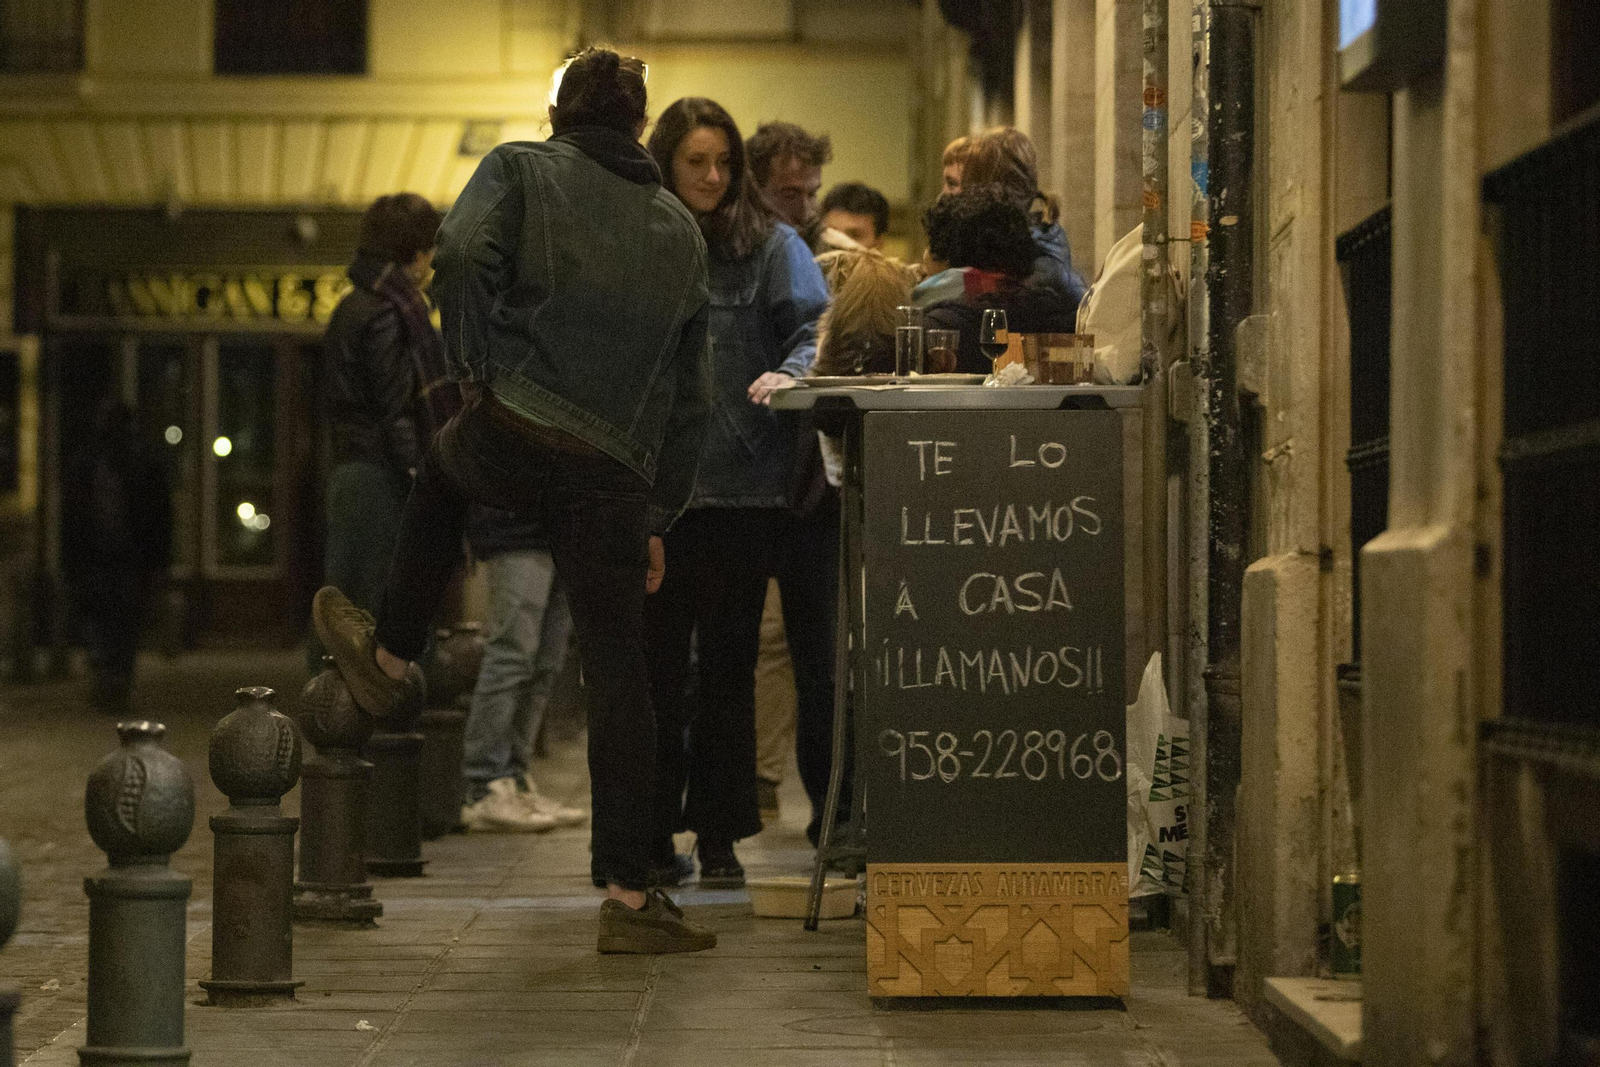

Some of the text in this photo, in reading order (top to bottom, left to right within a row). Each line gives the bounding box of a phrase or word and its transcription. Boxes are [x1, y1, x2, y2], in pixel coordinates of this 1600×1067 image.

[907, 435, 1067, 481] TE LO
[902, 496, 1101, 547] LLEVAMOS
[958, 567, 1073, 615] CASA
[878, 729, 1122, 783] 958-228968
[872, 871, 1120, 897] CERVEZAS ALHAMBRA
